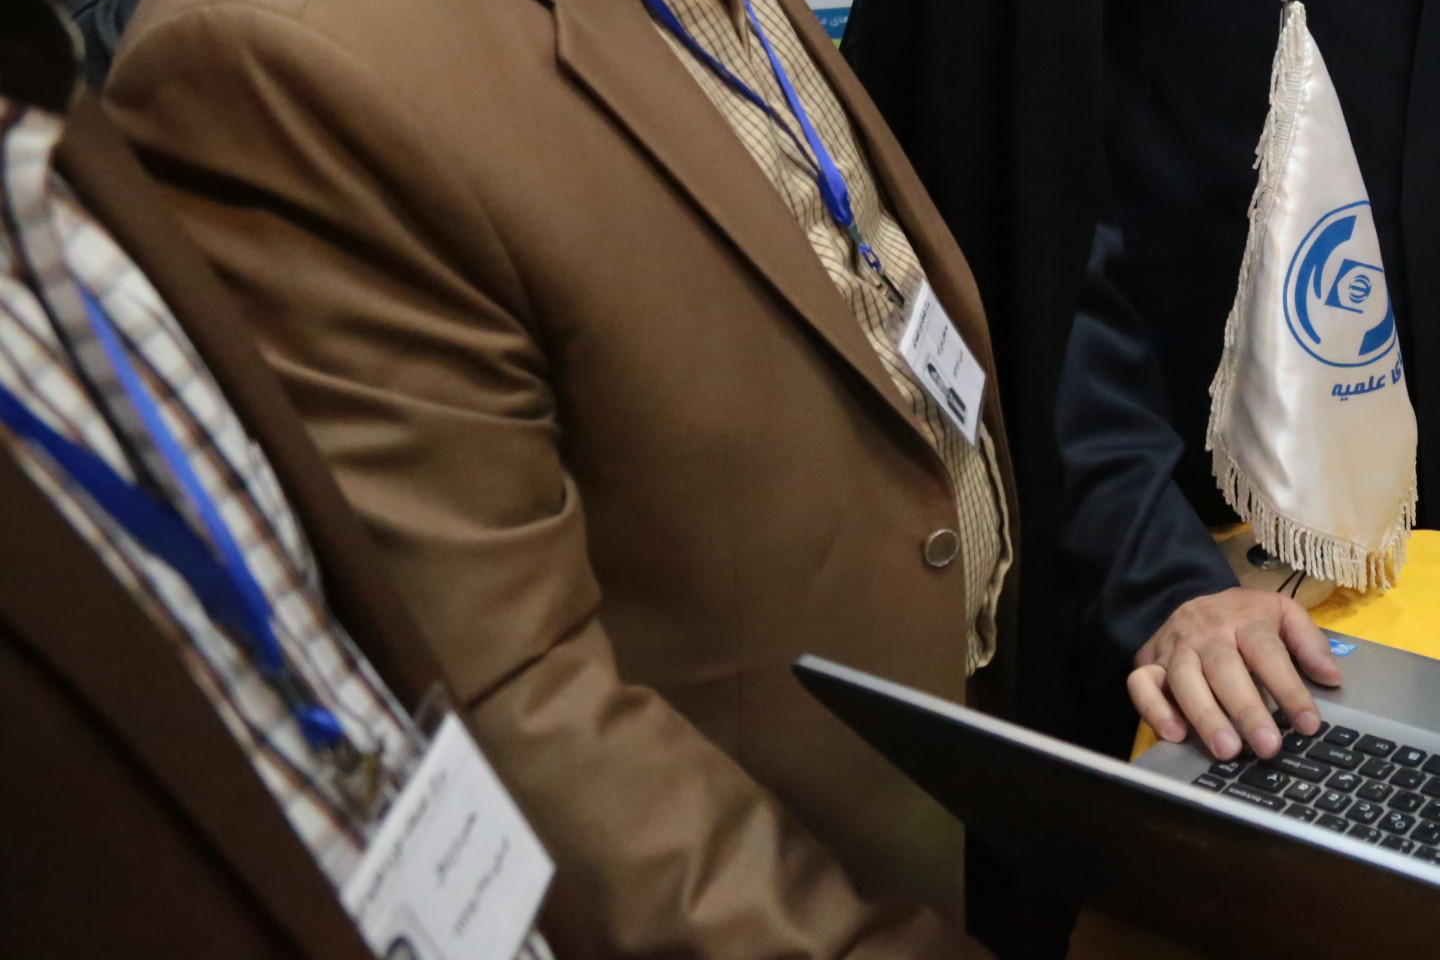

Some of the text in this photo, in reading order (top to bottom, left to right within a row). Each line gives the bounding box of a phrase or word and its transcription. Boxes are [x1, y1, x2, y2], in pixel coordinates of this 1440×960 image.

[1331, 375, 1386, 402] علمیه
[1376, 742, 1389, 750] Ctrl
[1364, 810, 1374, 819] P
